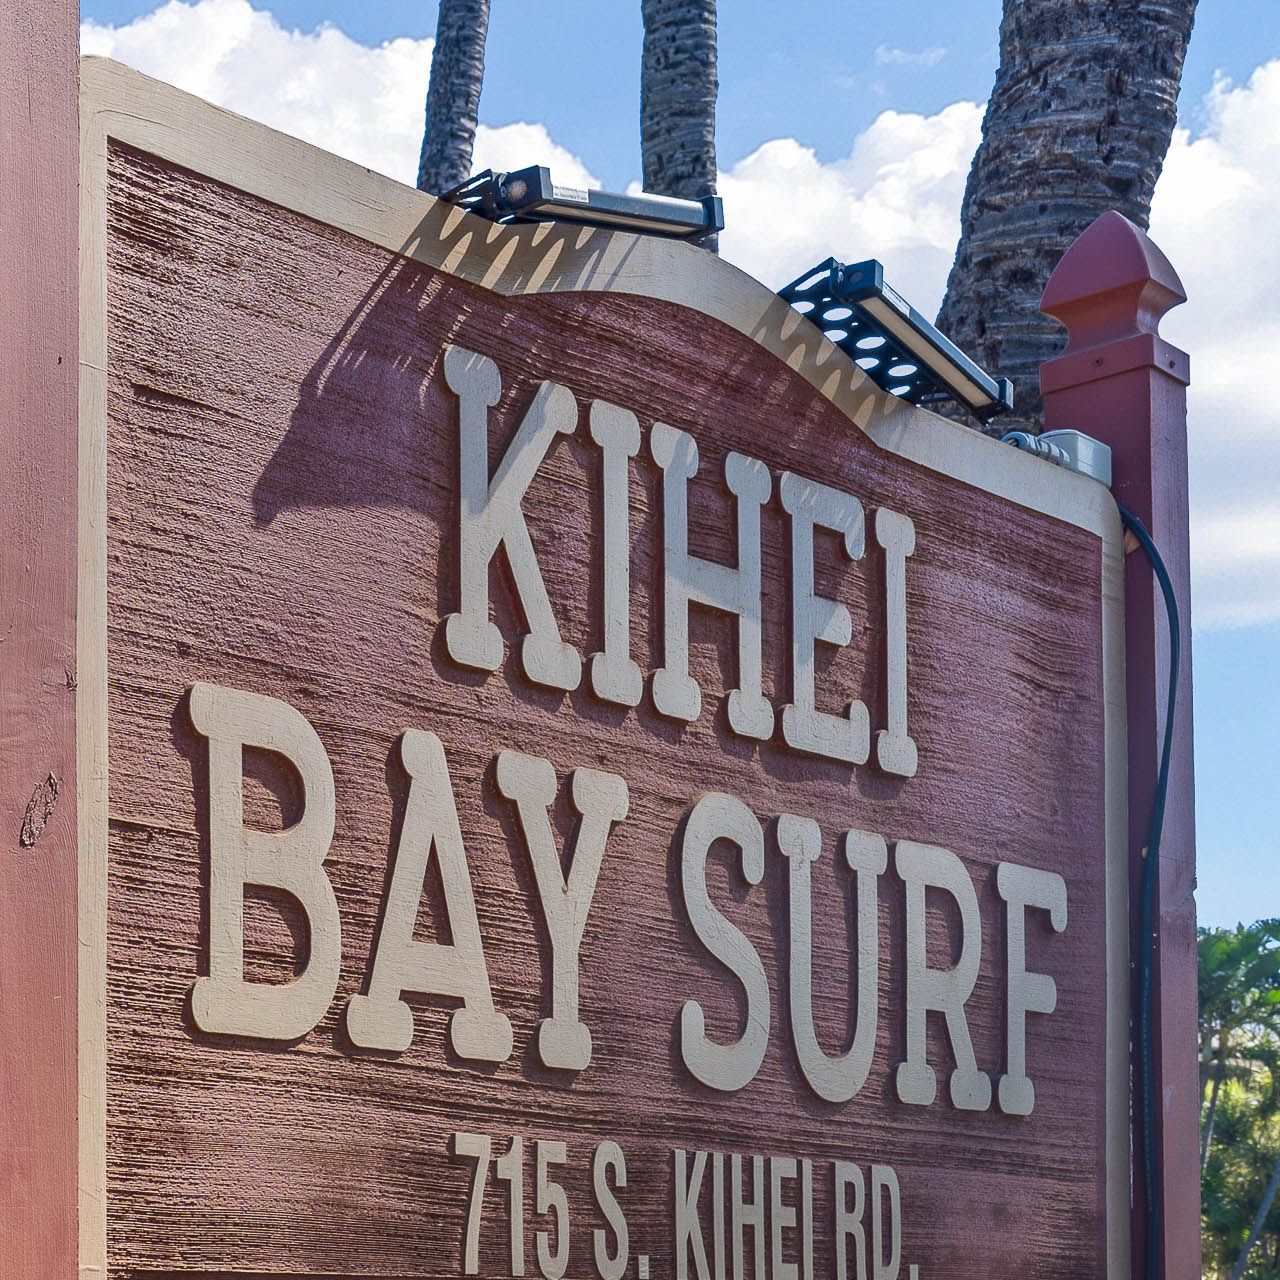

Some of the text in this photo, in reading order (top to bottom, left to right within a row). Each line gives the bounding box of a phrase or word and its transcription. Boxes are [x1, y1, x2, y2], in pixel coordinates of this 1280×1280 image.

[443, 344, 919, 778] KIHEI
[189, 681, 1069, 1117] BAY SURF
